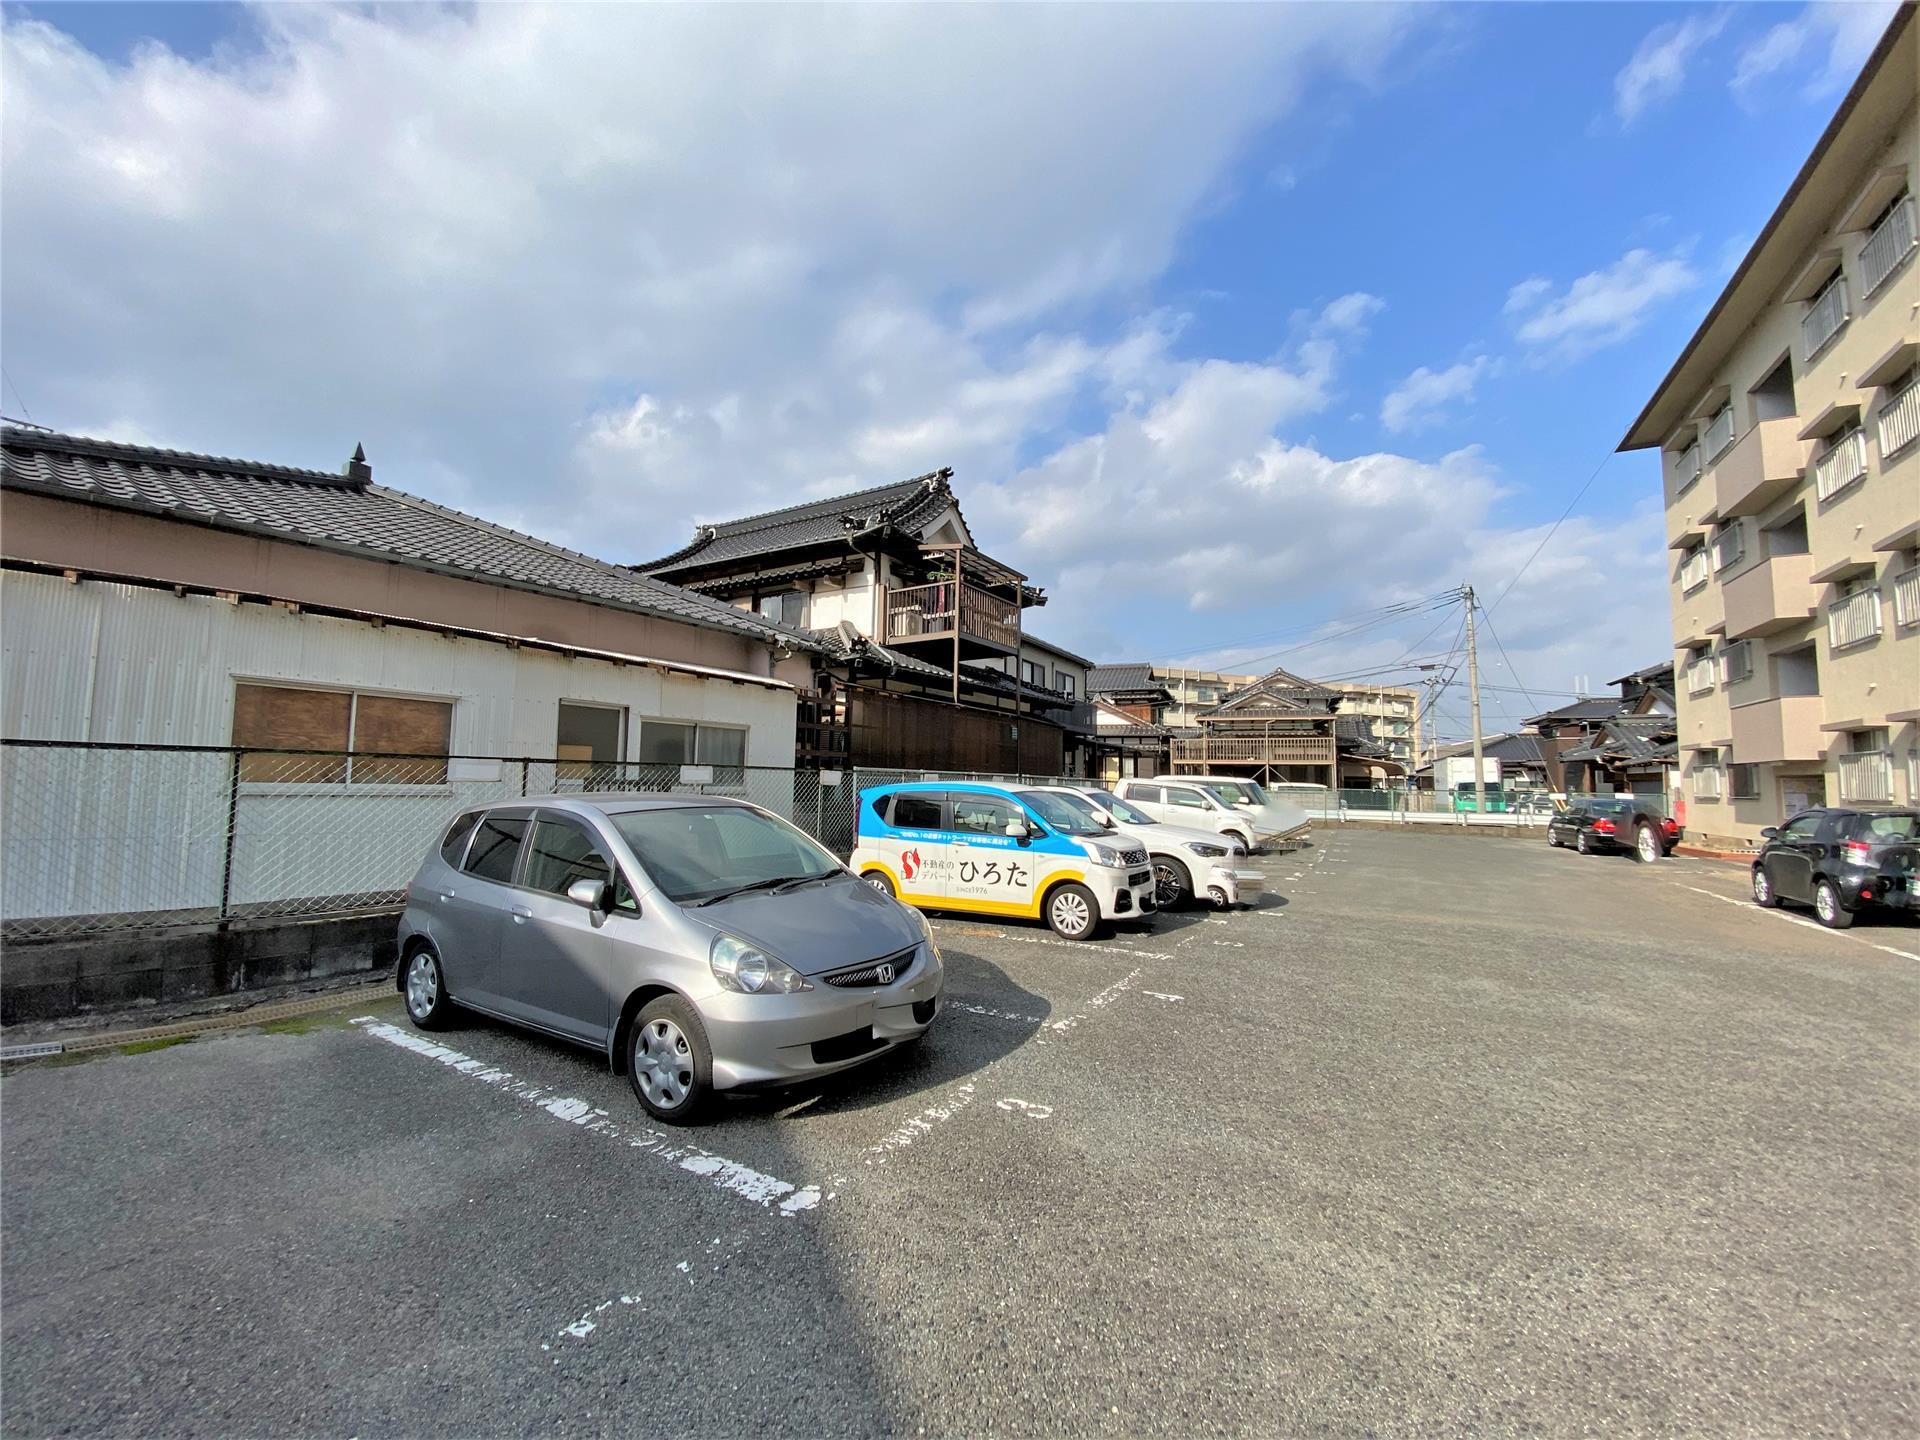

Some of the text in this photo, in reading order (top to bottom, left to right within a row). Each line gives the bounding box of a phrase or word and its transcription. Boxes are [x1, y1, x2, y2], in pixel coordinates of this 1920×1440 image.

[922, 859, 955, 870] 不動産の
[921, 870, 954, 882] デパート
[960, 861, 1028, 887] ひろた
